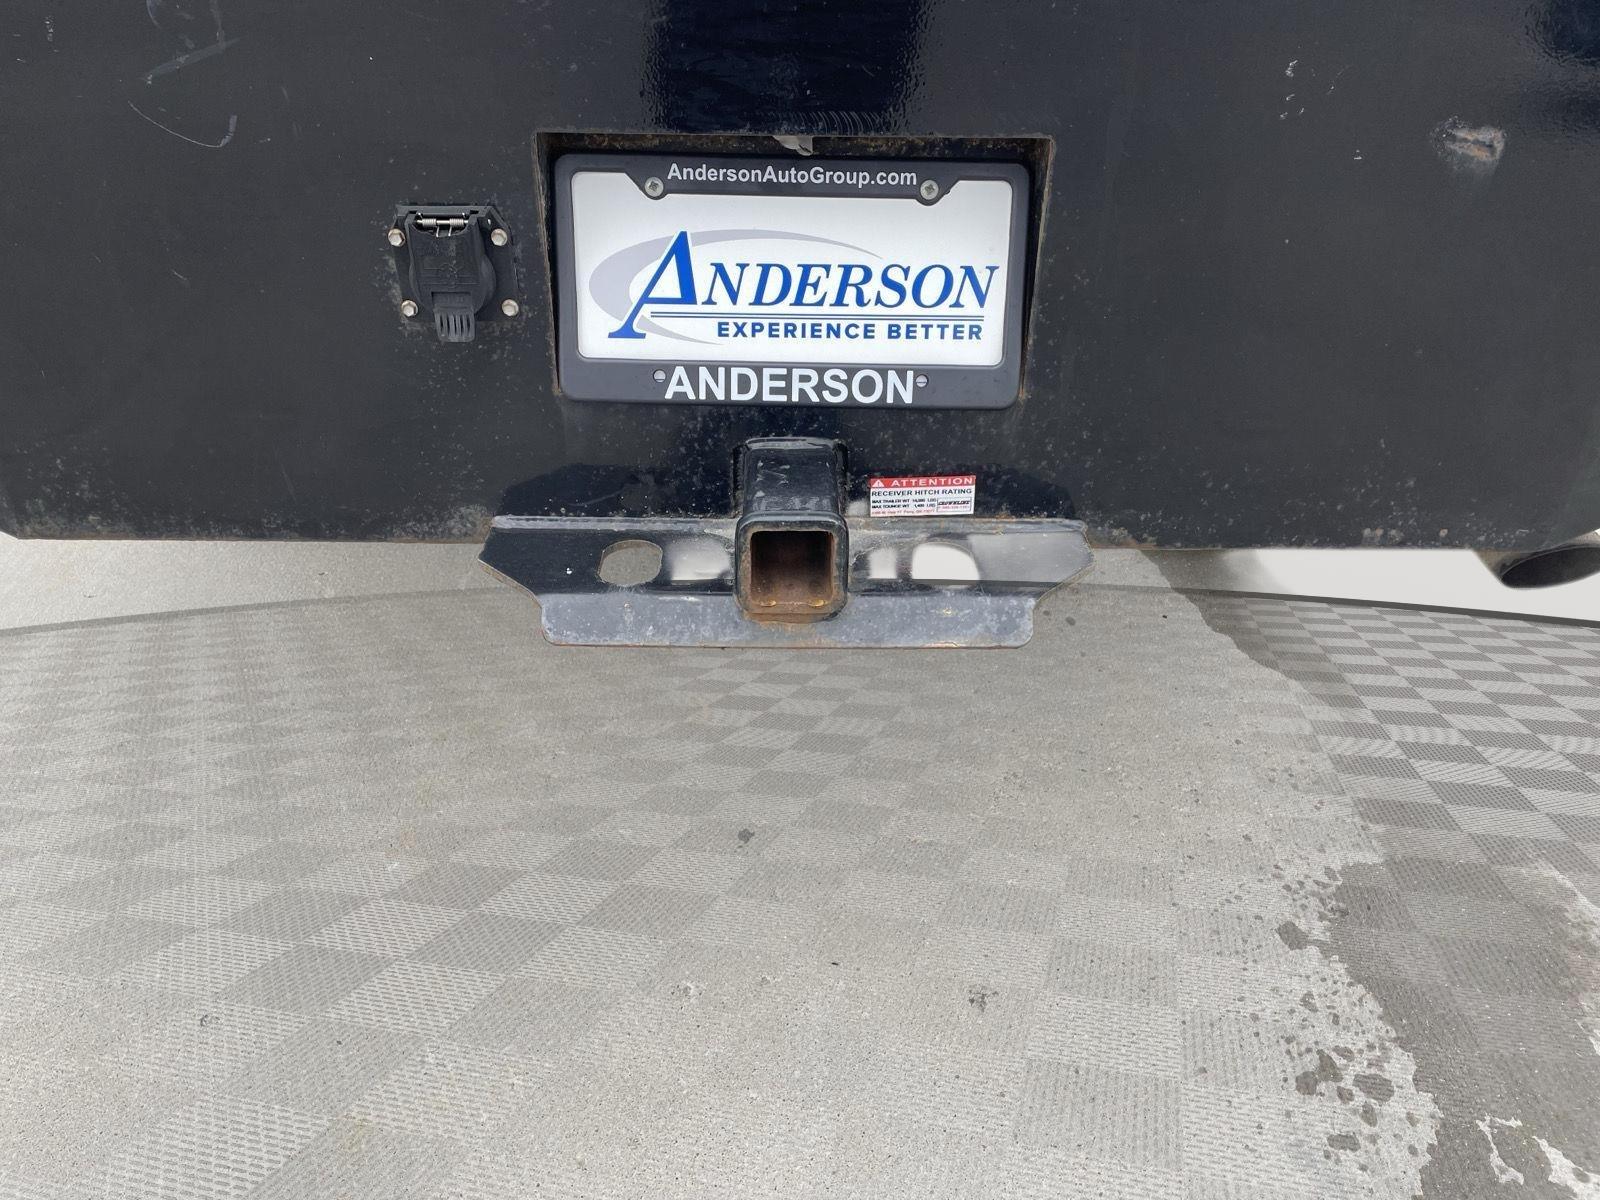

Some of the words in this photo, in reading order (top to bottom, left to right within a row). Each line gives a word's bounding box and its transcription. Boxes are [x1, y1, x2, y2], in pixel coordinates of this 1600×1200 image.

[667, 163, 917, 188] AndersonAutoGroup.com
[607, 230, 999, 339] ANDERSON
[717, 321, 876, 339] EXPERIENCE
[888, 322, 983, 340] BETTER
[664, 365, 914, 404] ANDERSON
[890, 477, 973, 487] ATTENTION
